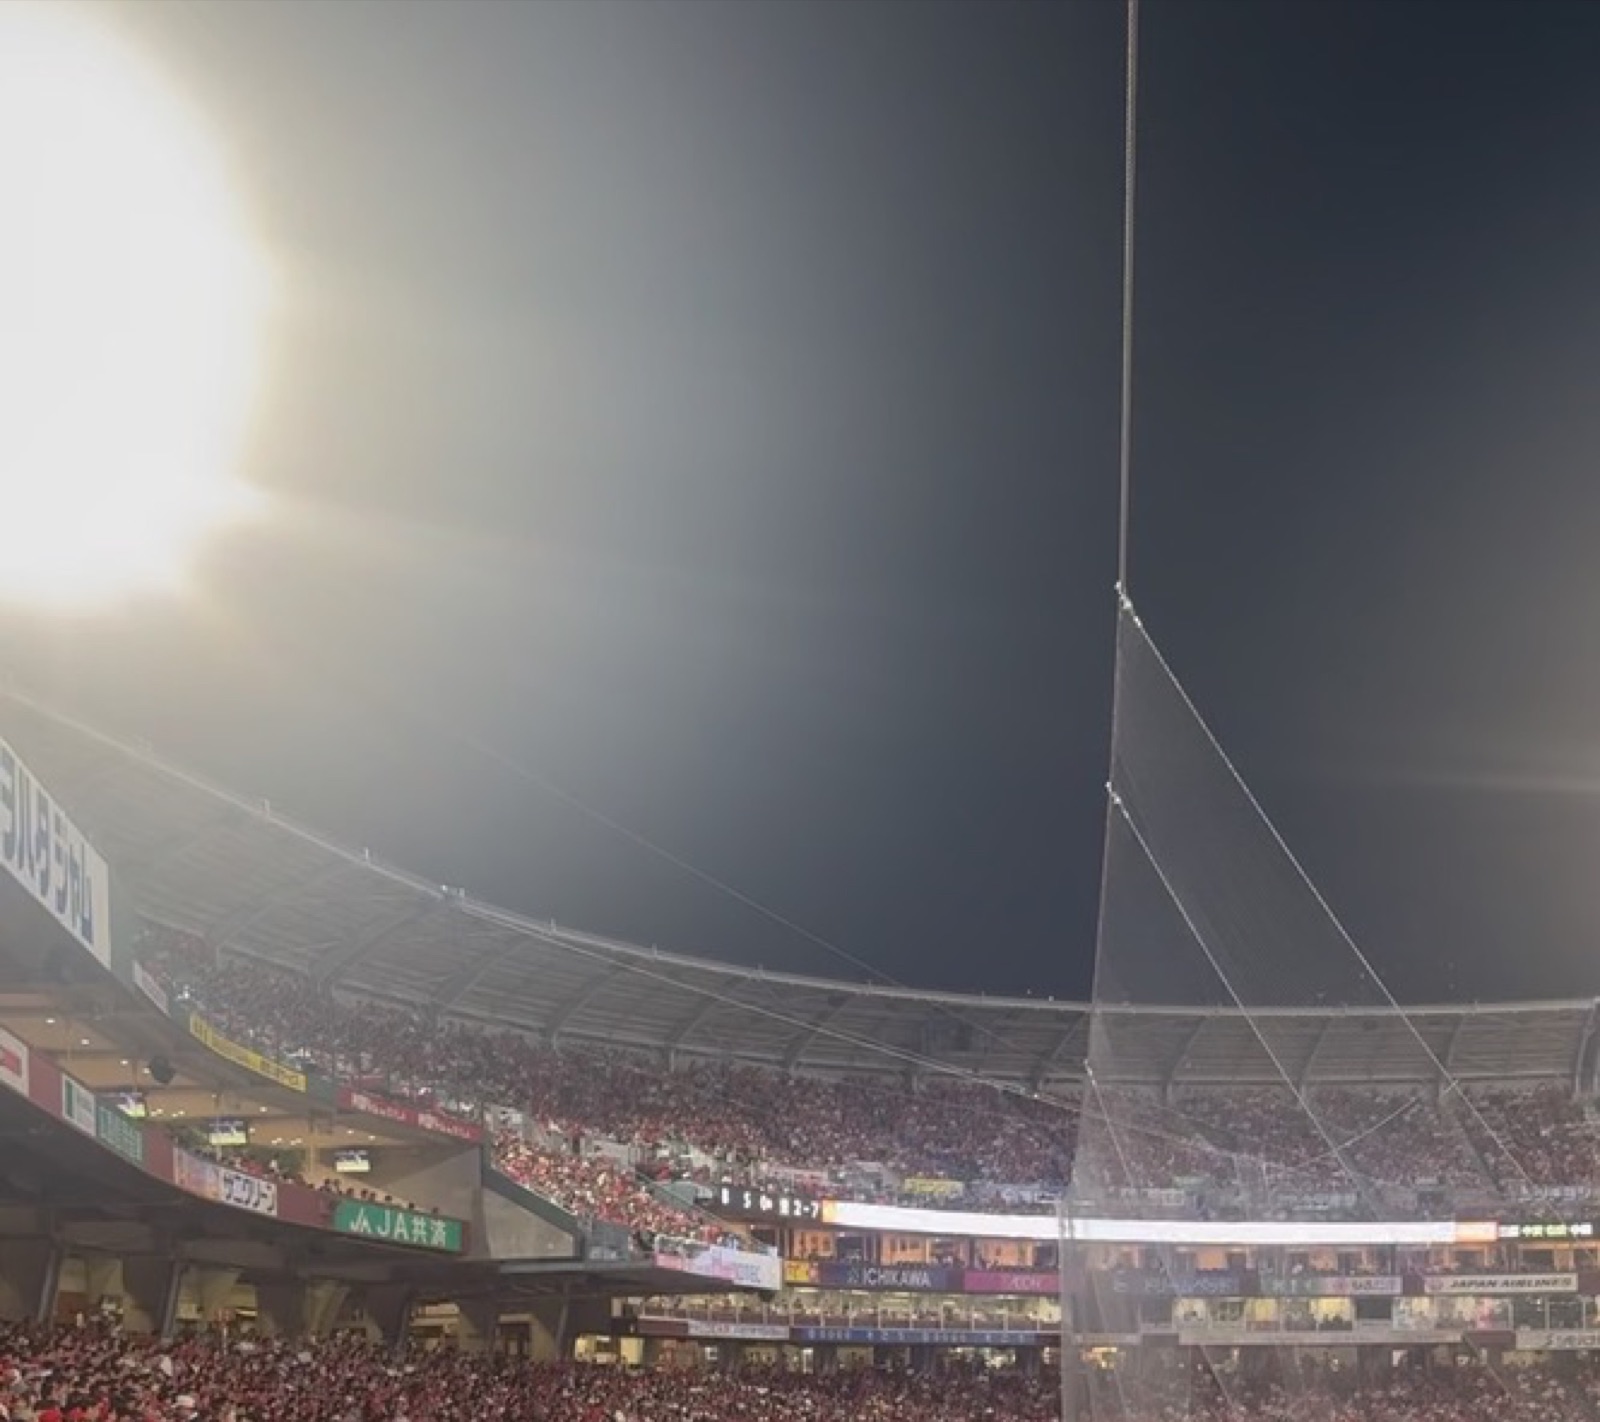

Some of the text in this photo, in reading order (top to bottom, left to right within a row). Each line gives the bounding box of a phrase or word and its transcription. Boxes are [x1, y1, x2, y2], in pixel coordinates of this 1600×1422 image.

[863, 1267, 932, 1287] ICHIKAWA
[1450, 1278, 1572, 1288] JAPAN AIRLINES
